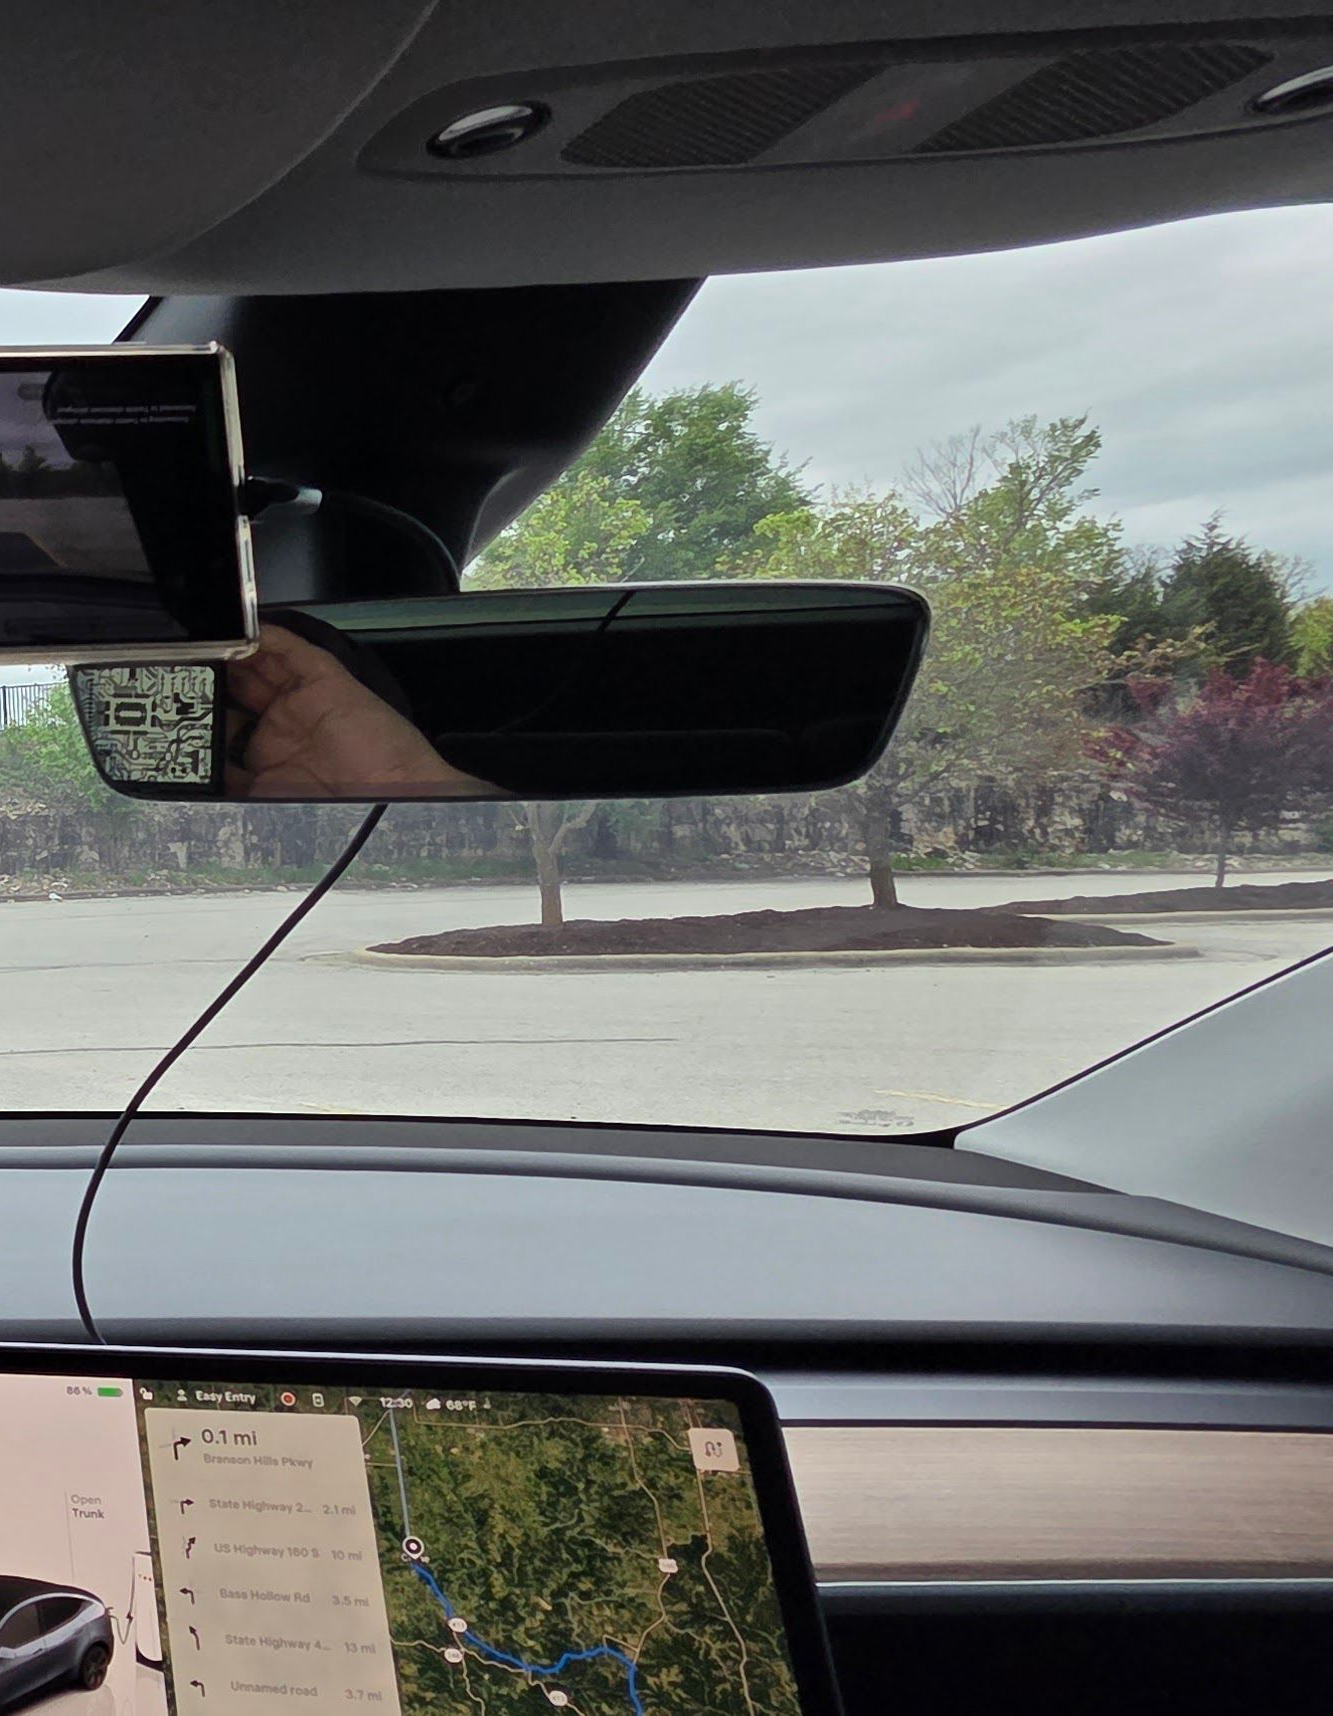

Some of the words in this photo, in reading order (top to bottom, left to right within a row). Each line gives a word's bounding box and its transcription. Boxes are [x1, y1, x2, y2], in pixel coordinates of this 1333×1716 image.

[195, 1390, 222, 1403] Easy
[225, 1391, 256, 1405] Entry
[380, 1397, 413, 1409] 12:30
[201, 1428, 228, 1445] 0.1
[234, 1430, 257, 1446] mi
[203, 1453, 251, 1466] Branson
[254, 1454, 278, 1466] Hills
[282, 1457, 313, 1470] Pkwy
[71, 1494, 101, 1507] Open
[209, 1499, 240, 1510] State
[242, 1501, 292, 1514] Highway
[72, 1508, 105, 1520] Trunk
[341, 1505, 356, 1515] mi
[214, 1543, 231, 1553] US
[233, 1544, 284, 1558] Highway
[331, 1550, 345, 1560] 10
[348, 1551, 362, 1561] mi
[219, 1588, 248, 1599] Bass
[250, 1590, 291, 1602] Hollow
[294, 1593, 311, 1603] Rd
[354, 1597, 370, 1607] mi
[225, 1634, 256, 1646] State
[259, 1636, 311, 1651] Highway
[361, 1643, 376, 1654] mi
[230, 1681, 287, 1695] Unnamed
[290, 1685, 318, 1697] road
[367, 1690, 383, 1701] mi
